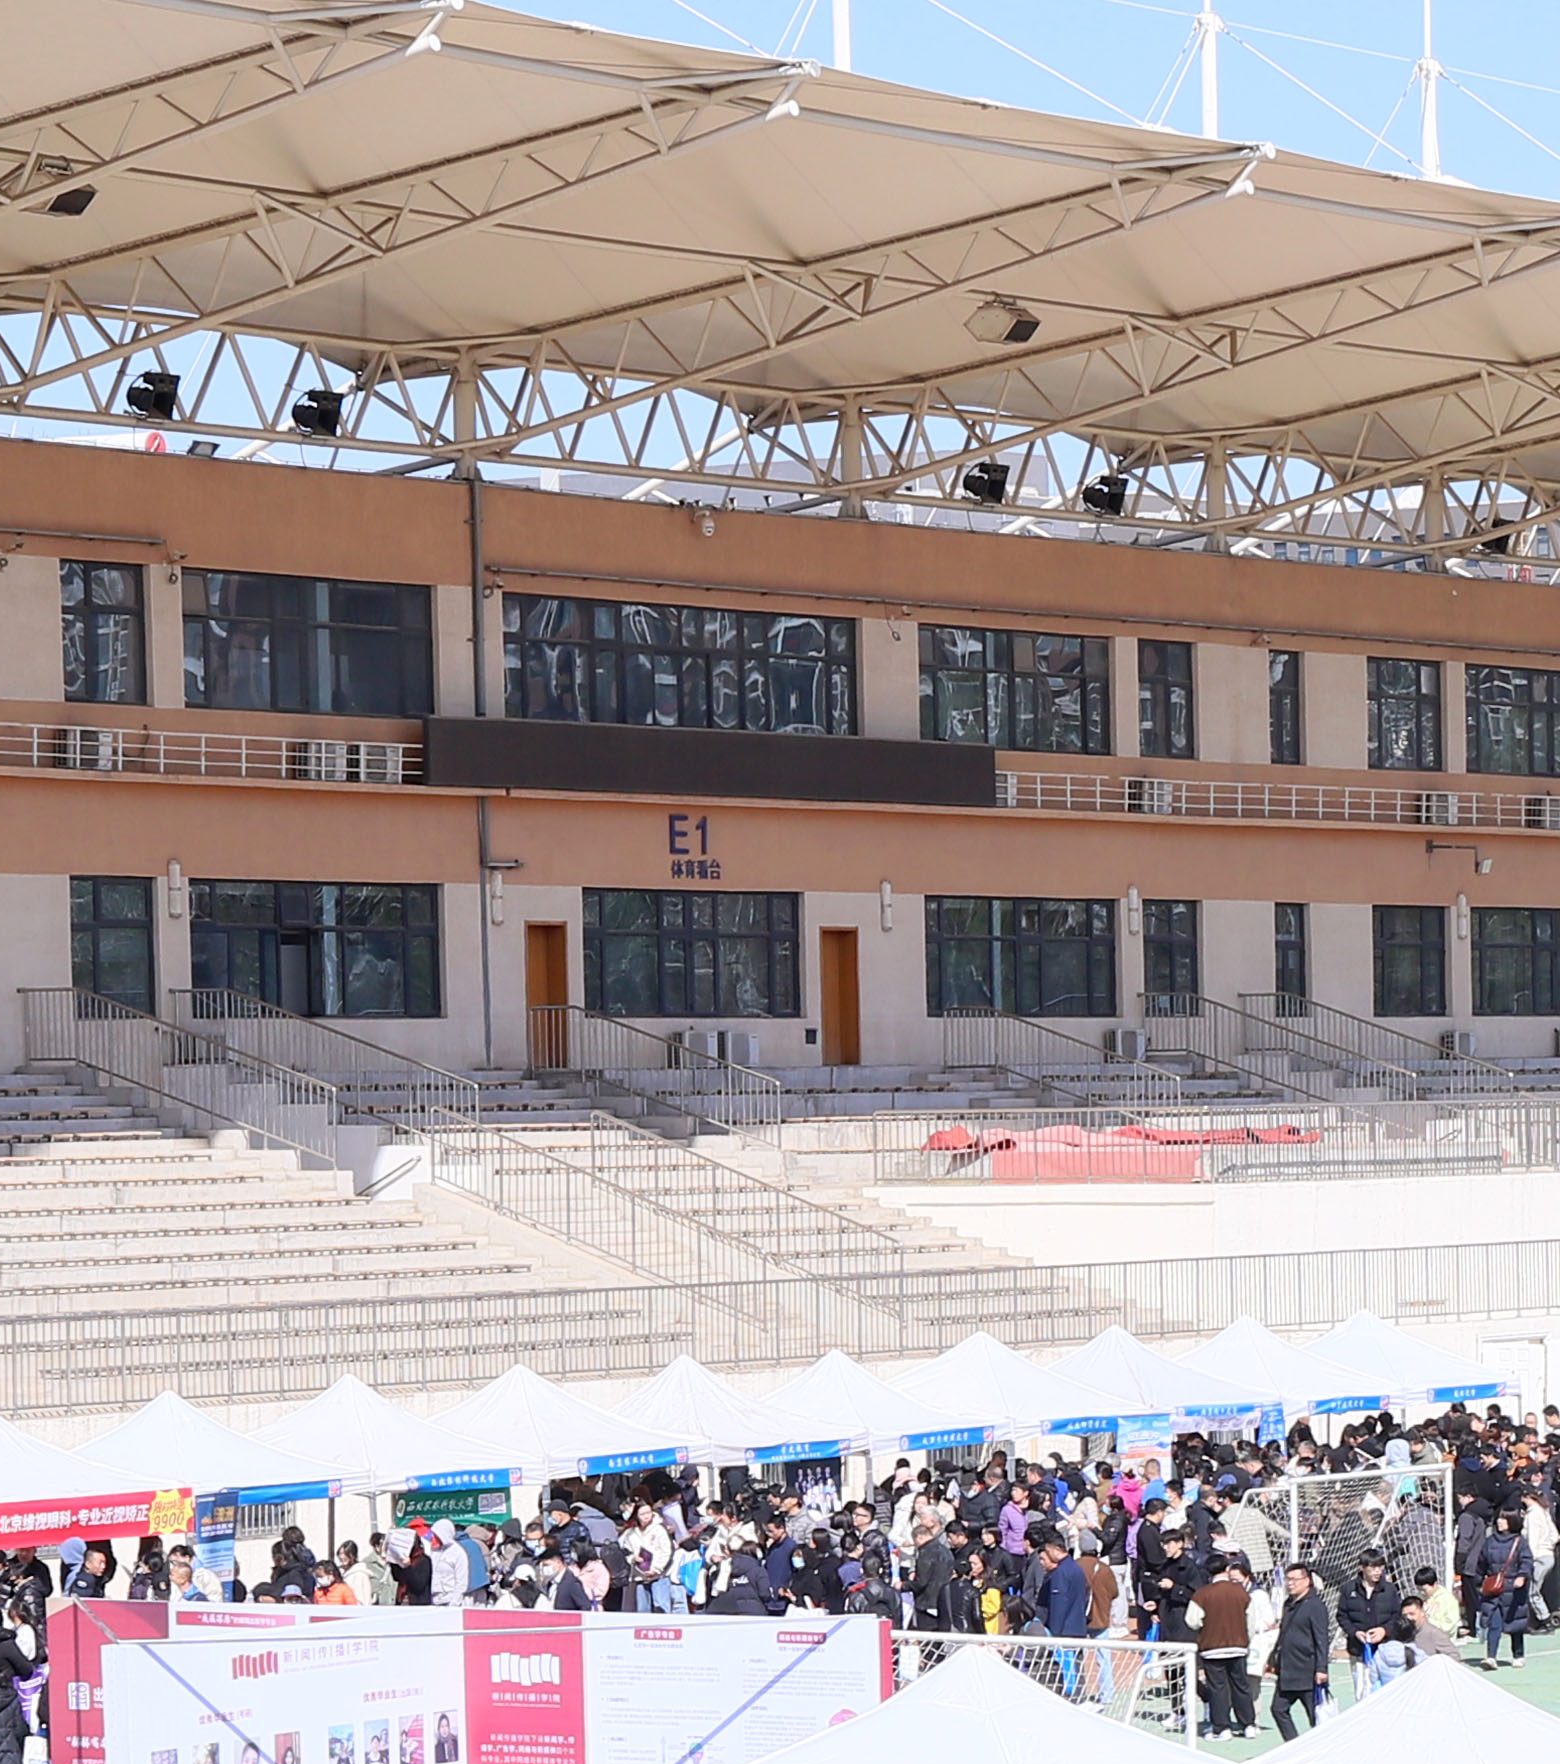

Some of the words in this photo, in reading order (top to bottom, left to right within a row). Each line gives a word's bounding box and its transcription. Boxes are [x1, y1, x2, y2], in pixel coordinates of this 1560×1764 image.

[668, 814, 710, 855] E1
[670, 859, 721, 880] 体育看台
